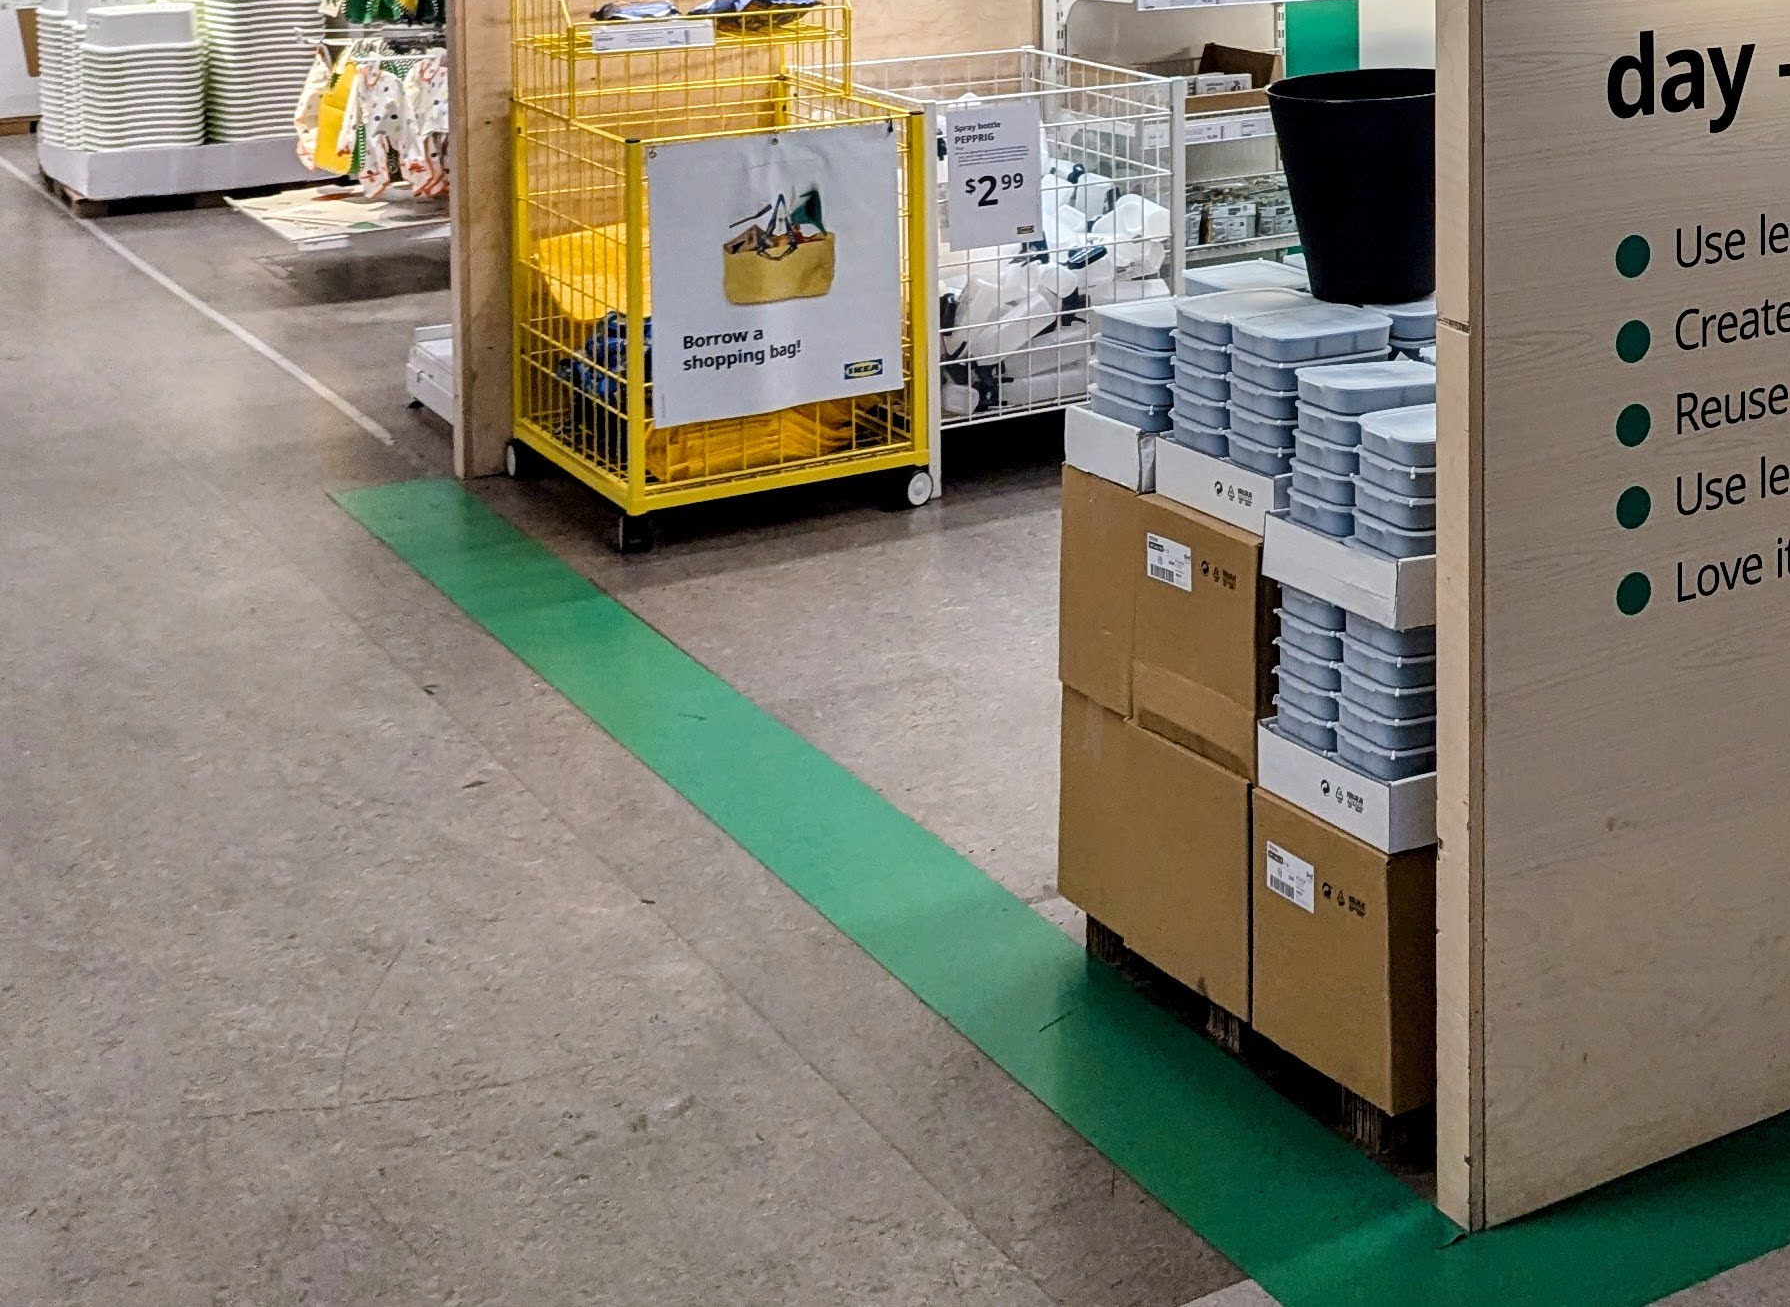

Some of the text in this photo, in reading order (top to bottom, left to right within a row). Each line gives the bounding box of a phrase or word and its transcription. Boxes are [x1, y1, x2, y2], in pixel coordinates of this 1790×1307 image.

[1607, 30, 1755, 133] day
[955, 122, 1001, 133] Spray bottle
[955, 133, 994, 144] PEPPRIG
[1675, 225, 1746, 268] Use
[683, 329, 764, 350] Borrow a
[683, 340, 802, 371] shopping bag!
[848, 364, 880, 374] IKEA
[1676, 382, 1789, 435] Reuse
[1676, 473, 1747, 516] Use
[1676, 554, 1763, 604] Love
